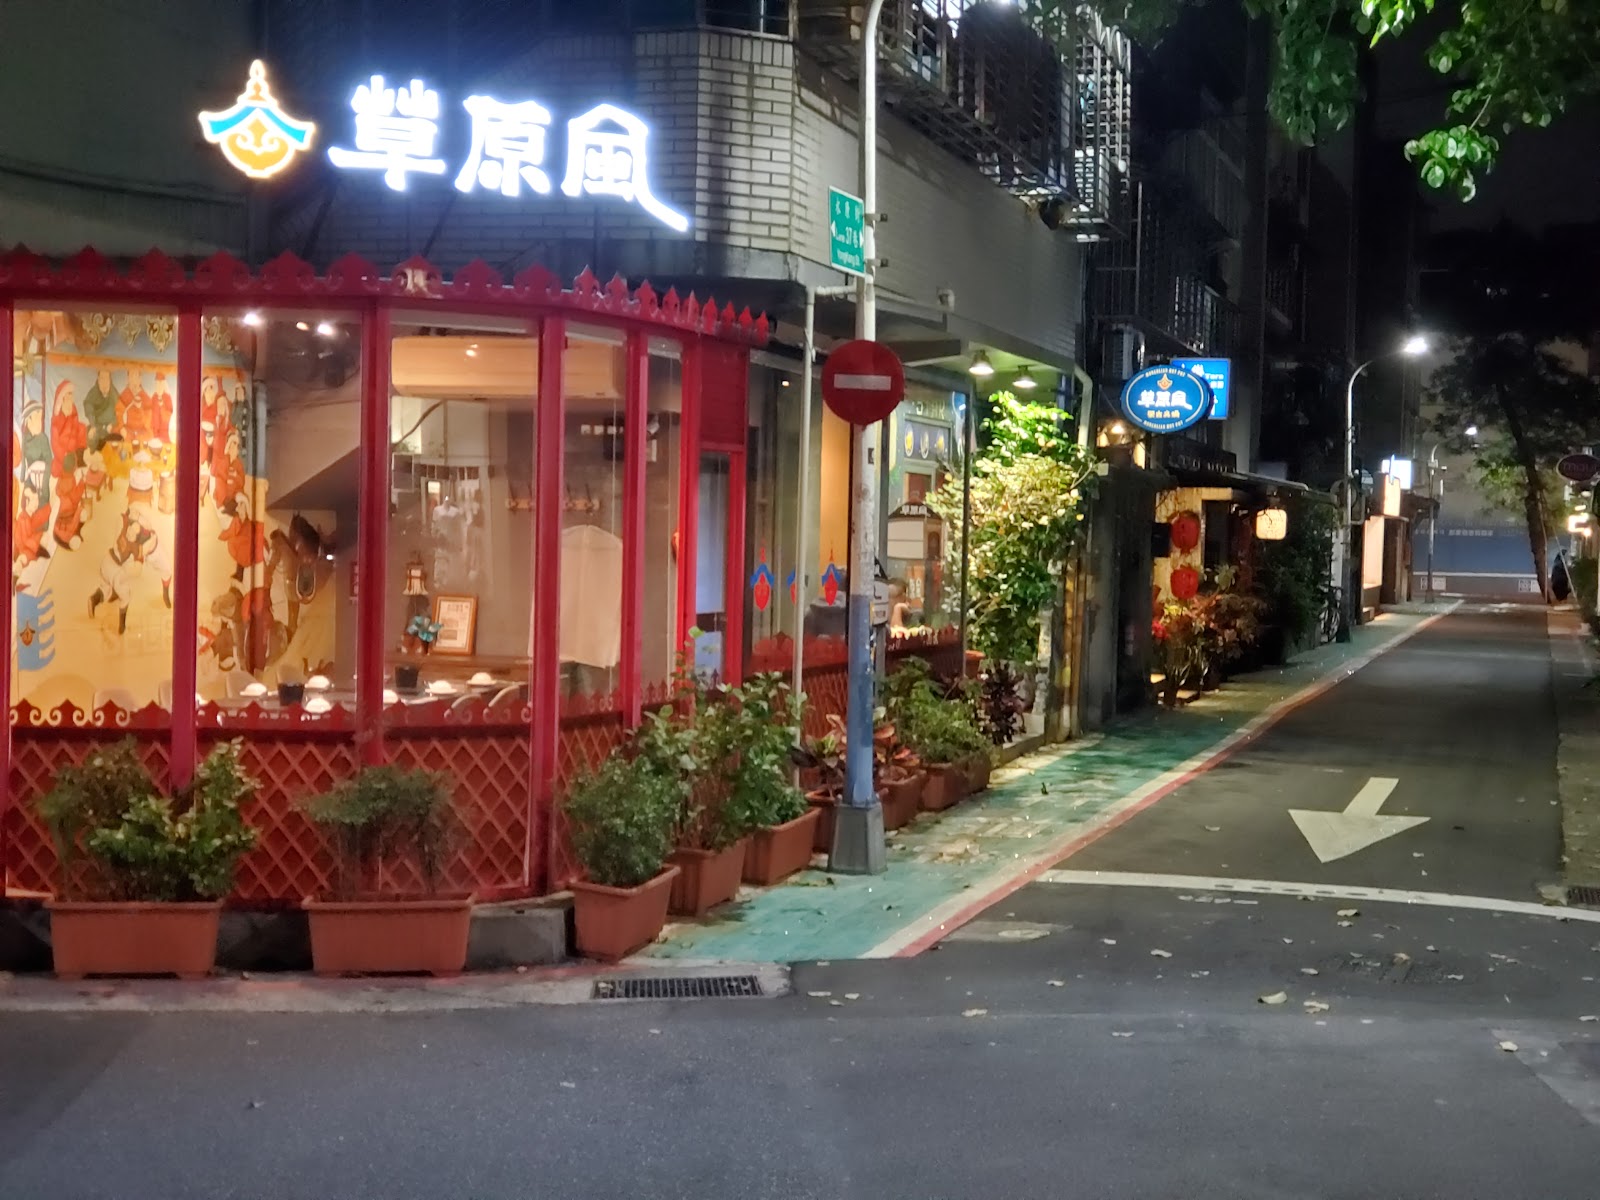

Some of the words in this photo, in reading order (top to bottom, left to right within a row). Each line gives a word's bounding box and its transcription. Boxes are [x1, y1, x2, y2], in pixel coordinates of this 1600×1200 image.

[327, 74, 689, 232] 草原風
[845, 227, 853, 245] 37
[1177, 369, 1186, 377] POT
[1137, 389, 1193, 411] 草原風
[1175, 420, 1184, 428] POT
